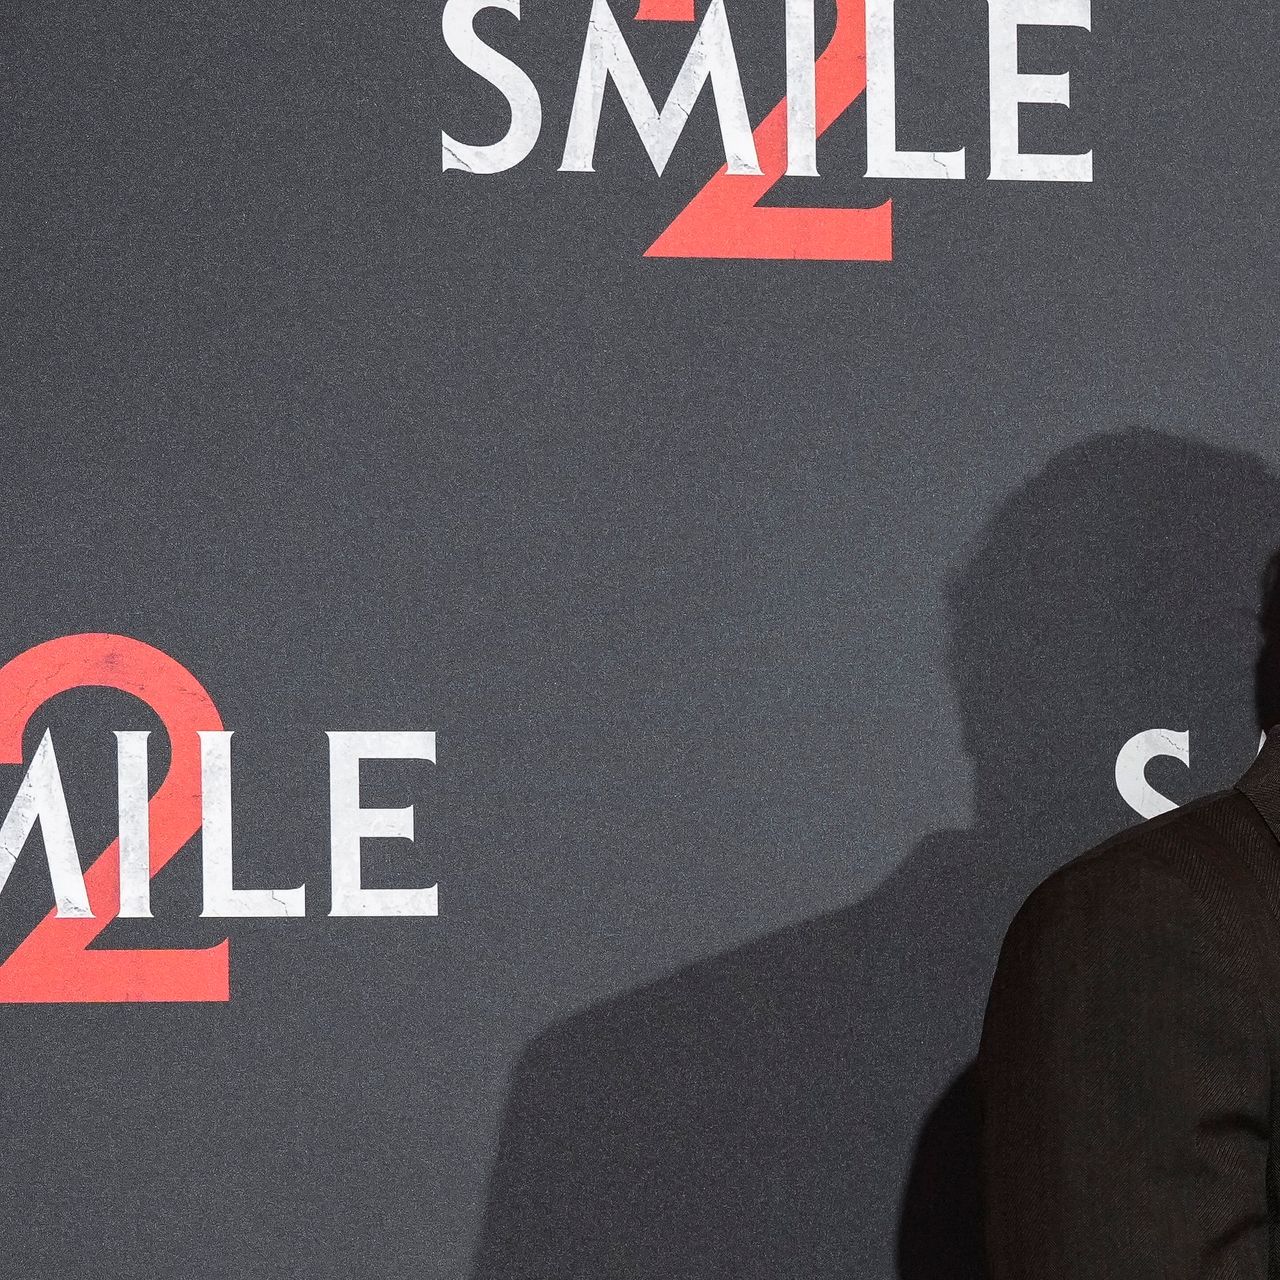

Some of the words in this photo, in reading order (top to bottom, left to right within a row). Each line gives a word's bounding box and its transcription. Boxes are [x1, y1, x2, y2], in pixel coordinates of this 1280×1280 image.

[441, 0, 1094, 183] SMILE
[635, 0, 893, 262] 2
[0, 632, 230, 1004] 2
